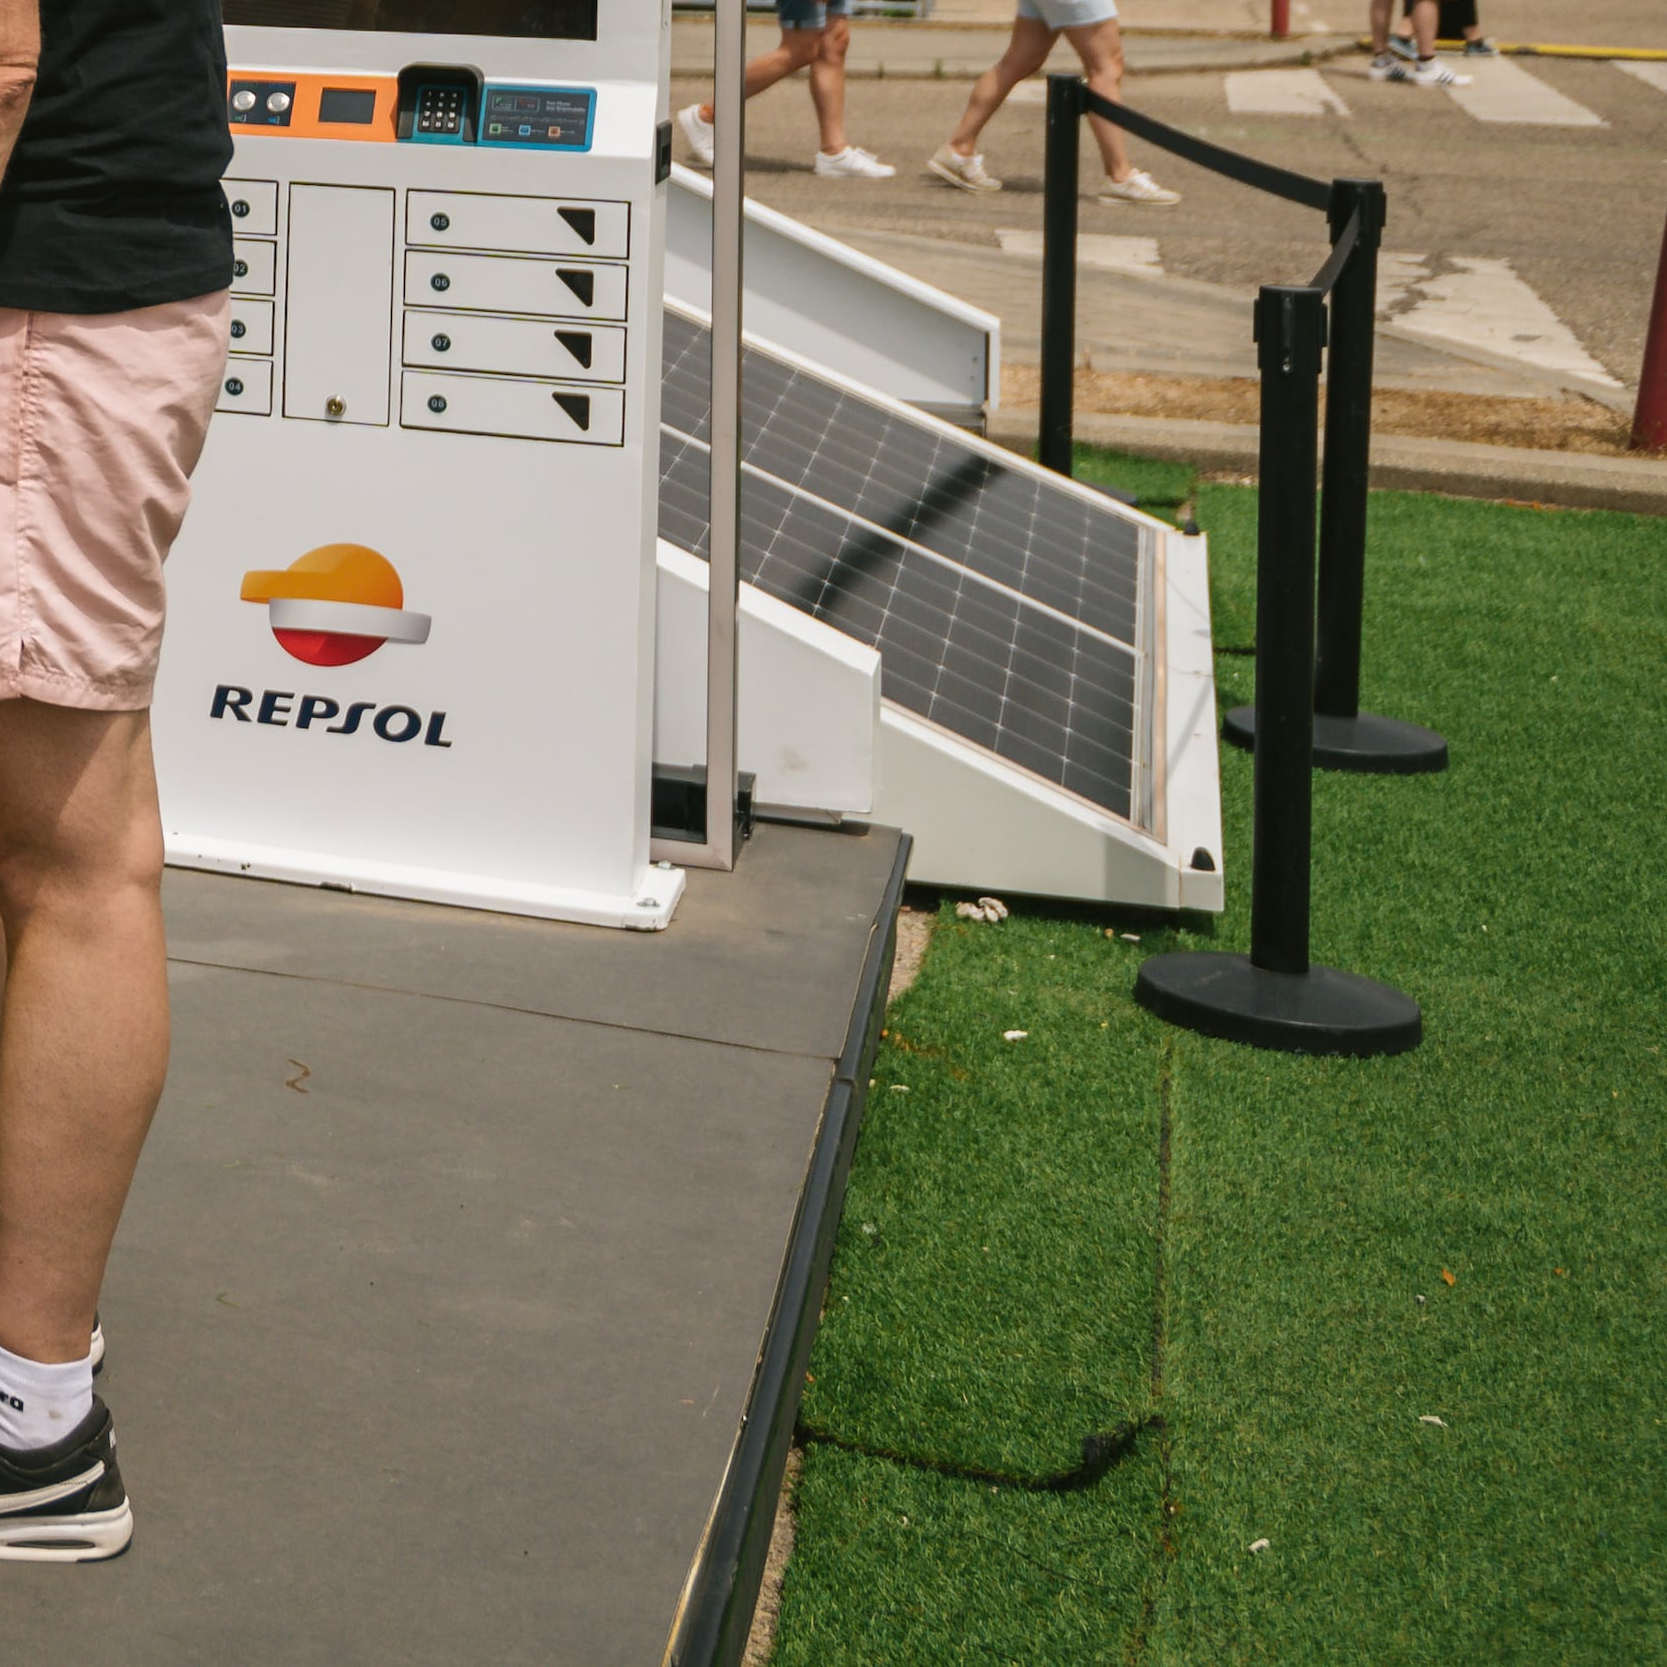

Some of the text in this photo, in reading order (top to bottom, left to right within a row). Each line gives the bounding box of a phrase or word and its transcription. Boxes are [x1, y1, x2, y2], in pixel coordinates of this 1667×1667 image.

[233, 203, 248, 214] 01
[433, 216, 447, 227] 05
[434, 277, 448, 288] 06
[435, 337, 449, 348] 07
[228, 381, 242, 392] 04
[430, 398, 445, 409] 08
[210, 684, 454, 748] REPSOL
